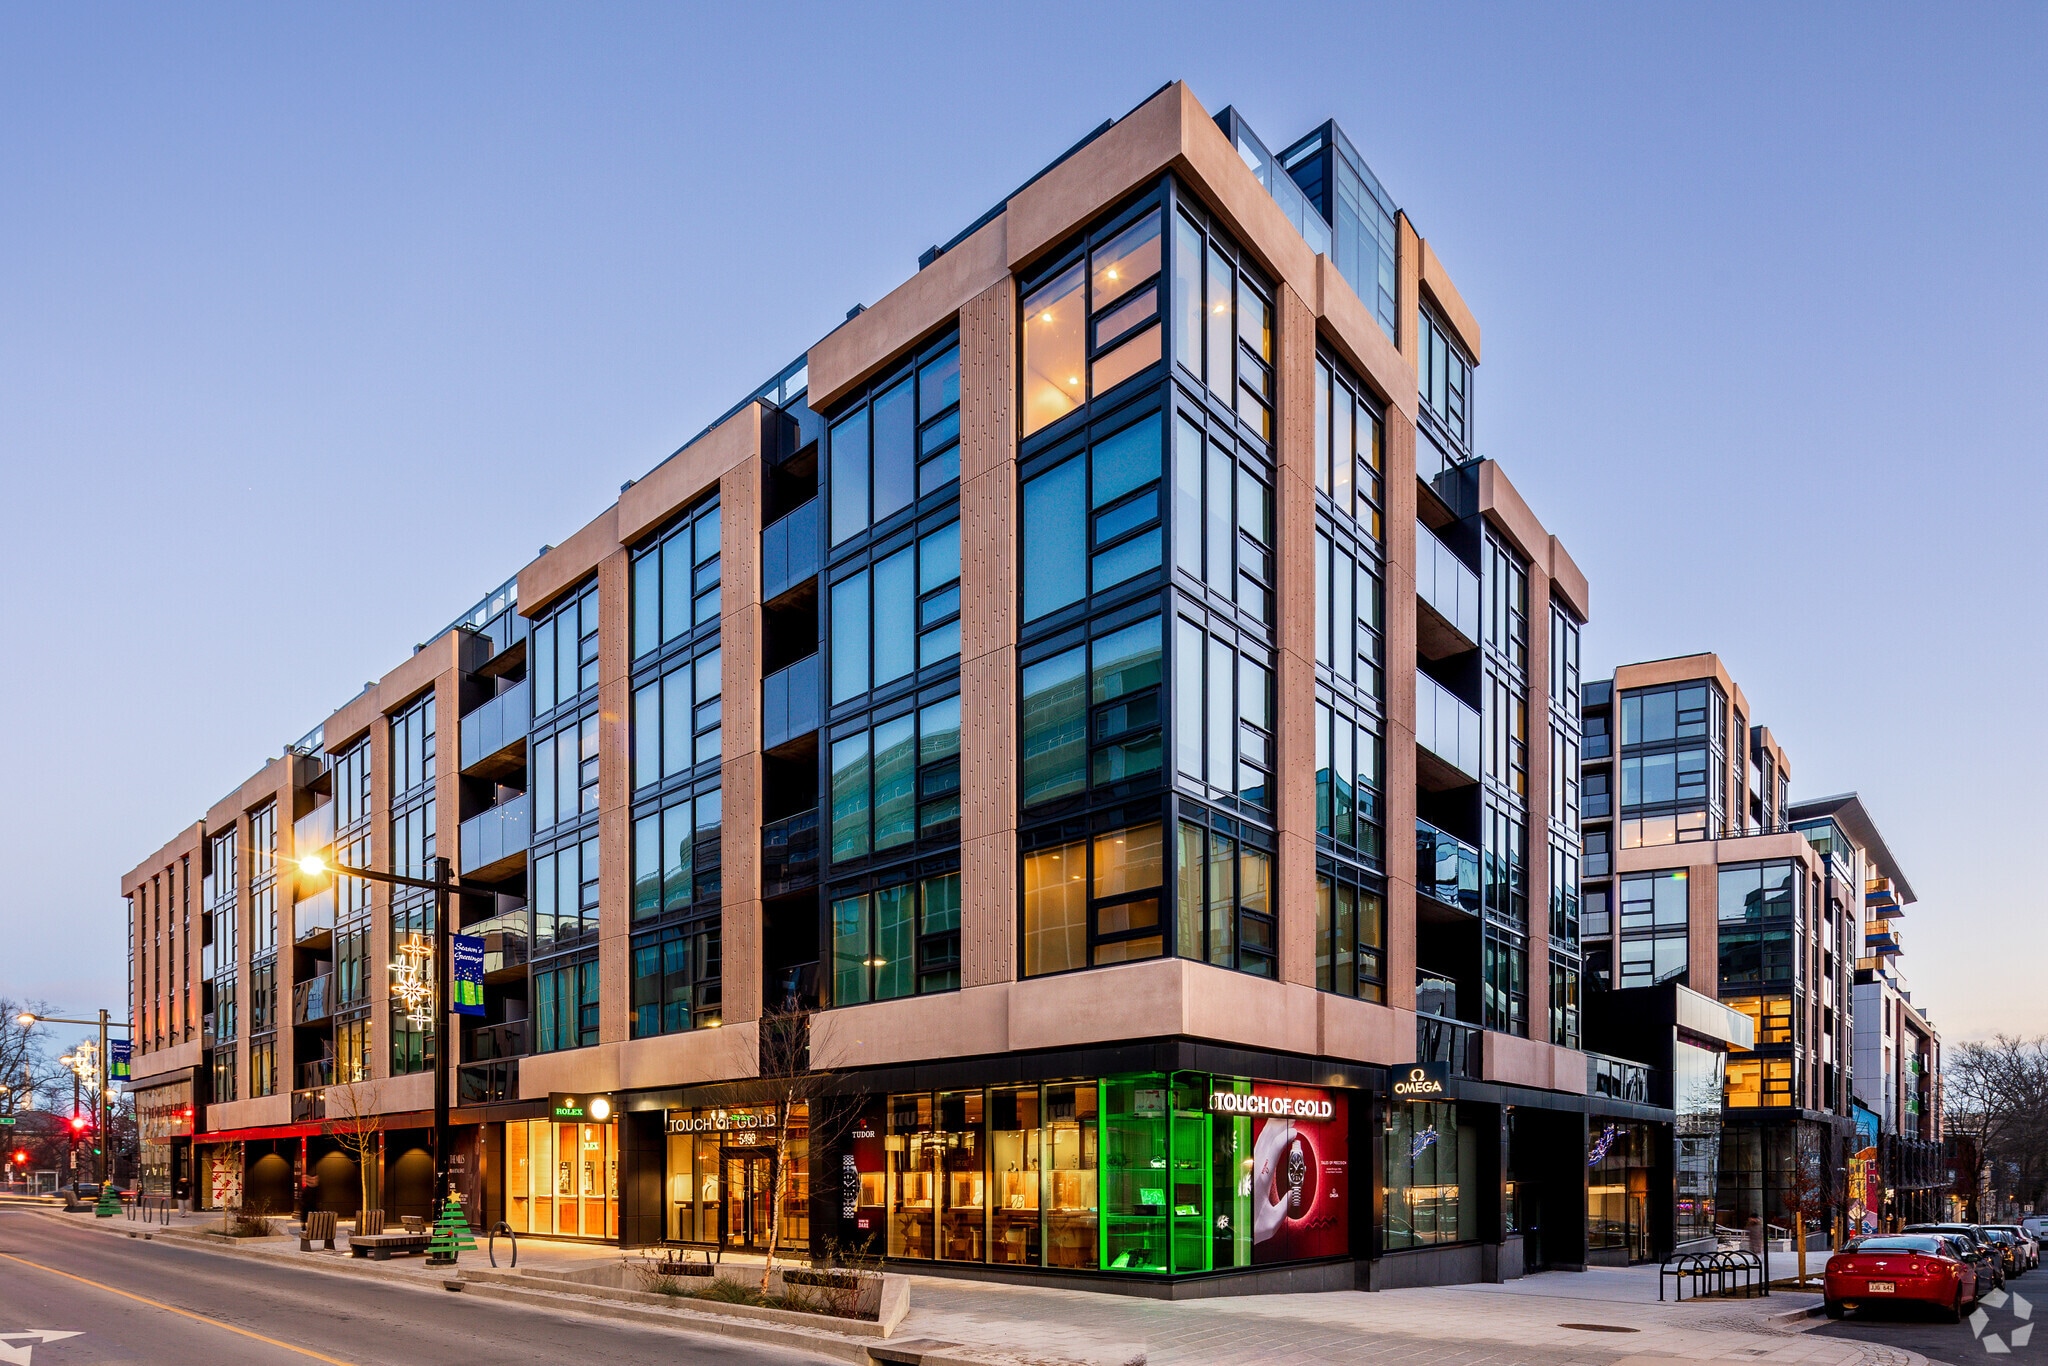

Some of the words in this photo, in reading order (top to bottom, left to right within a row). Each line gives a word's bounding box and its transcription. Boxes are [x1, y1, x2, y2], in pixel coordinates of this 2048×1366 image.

[454, 942, 483, 954] Season's
[454, 951, 483, 964] Greetings
[1394, 1080, 1443, 1095] OMEGA
[555, 1107, 584, 1116] ROLEX
[1213, 1092, 1269, 1113] TOUCH
[1271, 1097, 1292, 1115] OF
[1294, 1099, 1332, 1118] GOLD
[669, 1117, 712, 1132] TOUCH
[716, 1116, 731, 1130] OF
[737, 1113, 776, 1129] GOLD
[852, 1130, 875, 1139] TUDOR
